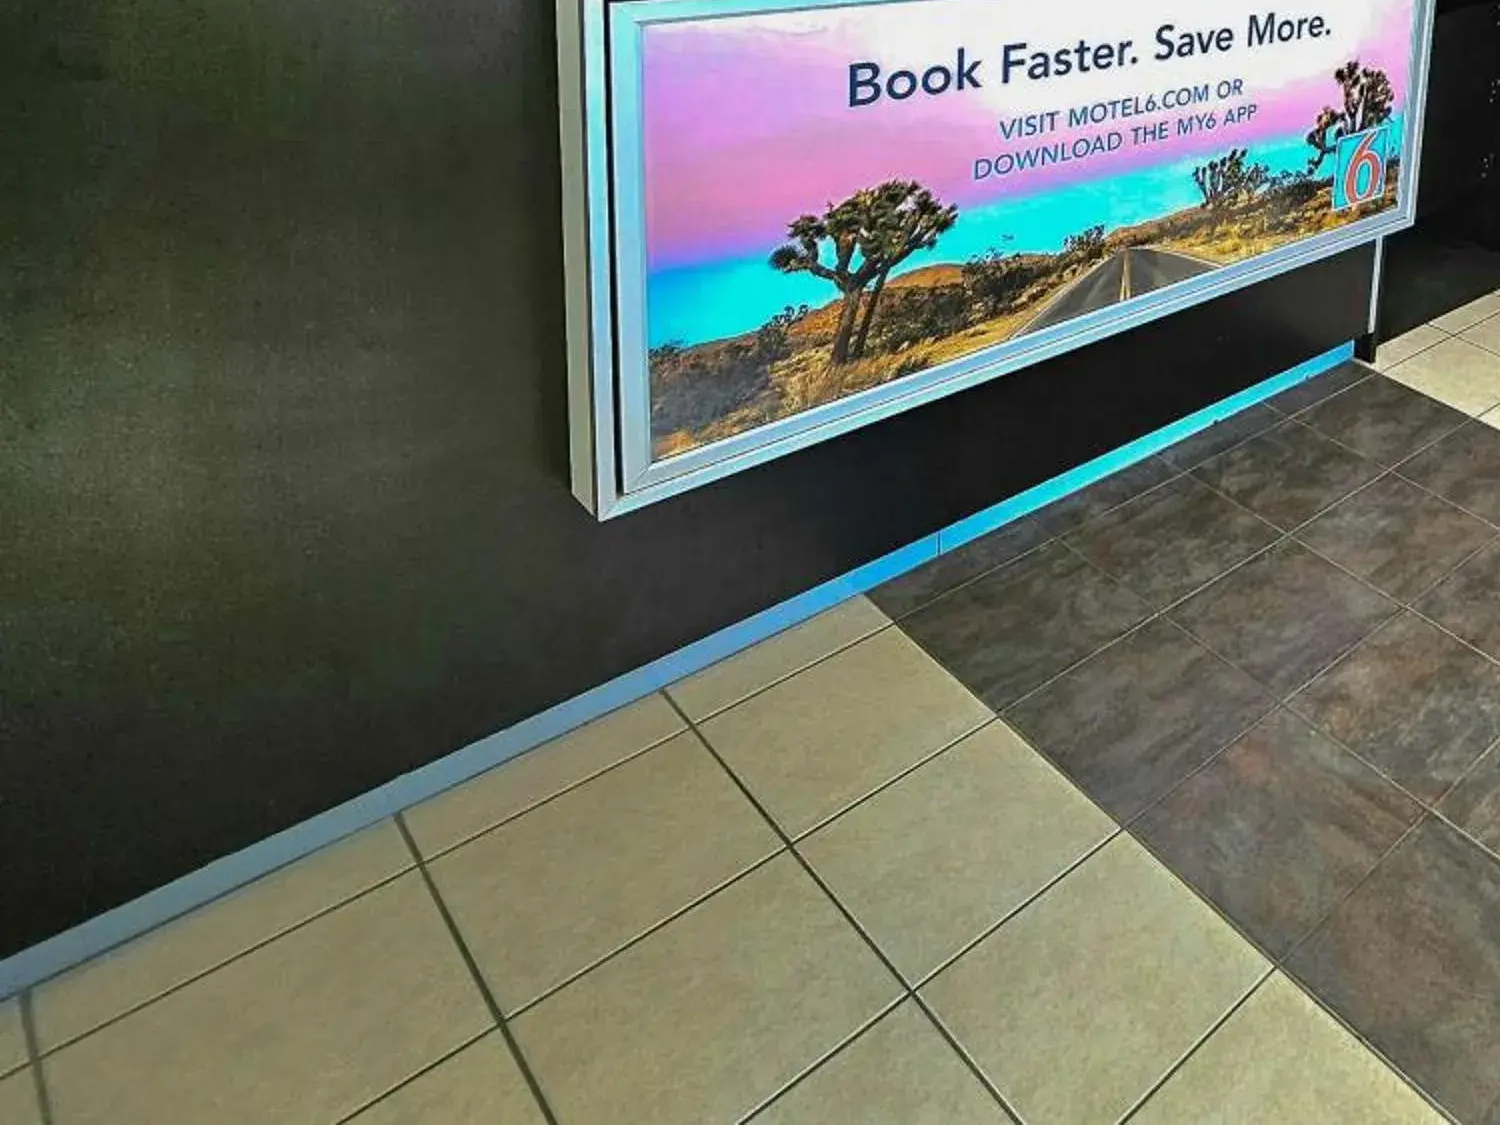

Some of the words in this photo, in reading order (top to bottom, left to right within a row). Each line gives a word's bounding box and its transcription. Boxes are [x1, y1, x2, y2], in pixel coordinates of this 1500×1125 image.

[849, 47, 982, 108] Book
[1000, 37, 1138, 85] Faster.
[1154, 24, 1234, 62] Save
[1247, 12, 1332, 48] More.
[973, 131, 1123, 181] DOWNLOAD
[1131, 121, 1169, 146] THE
[1177, 113, 1217, 137] MY6
[1223, 104, 1258, 127] APP
[999, 110, 1060, 141] VISIT
[1067, 84, 1210, 128] MOTEL6.COM
[1216, 78, 1245, 100] OR
[1344, 129, 1382, 206] 6
